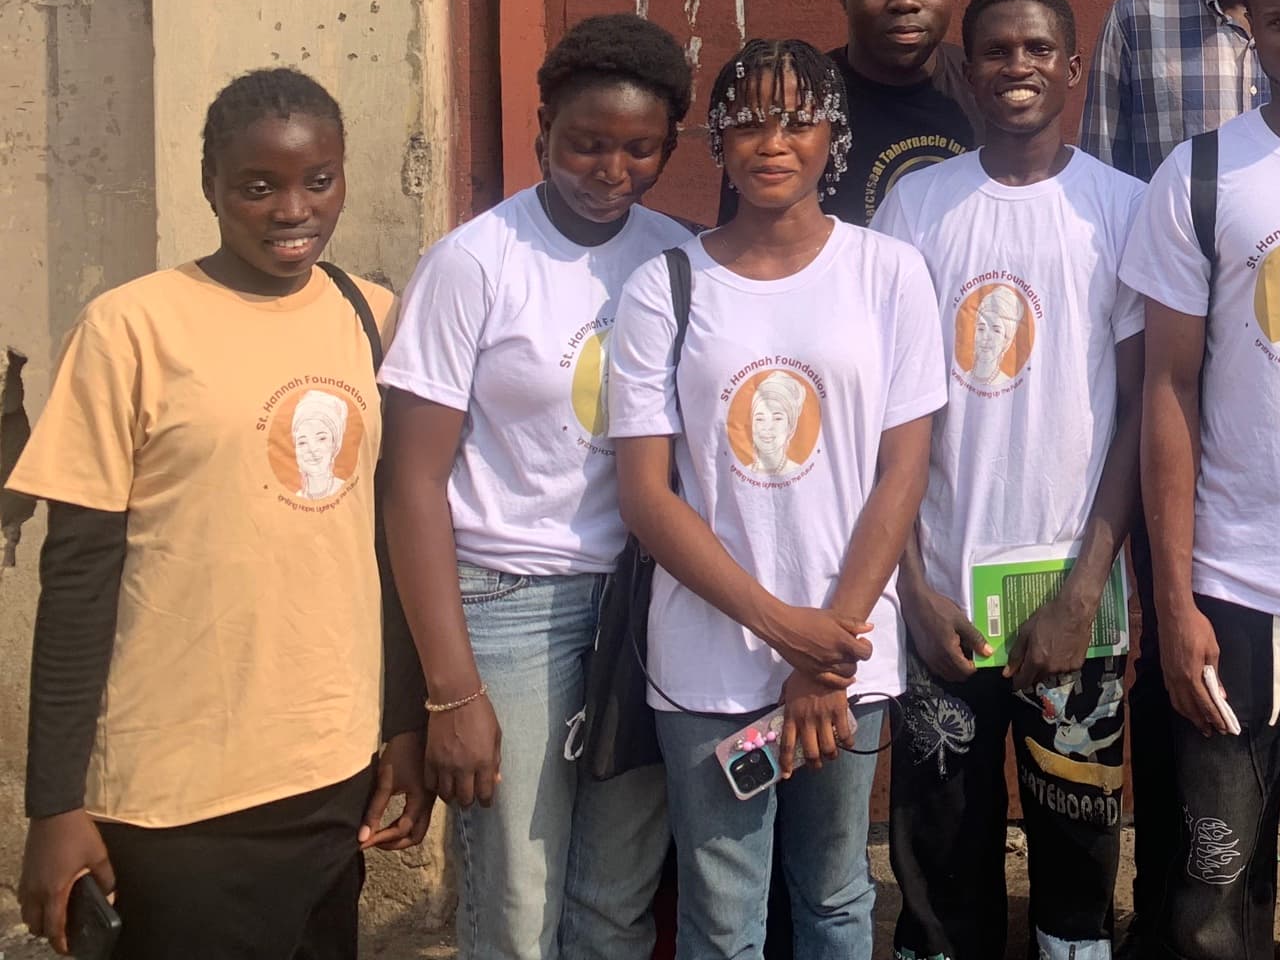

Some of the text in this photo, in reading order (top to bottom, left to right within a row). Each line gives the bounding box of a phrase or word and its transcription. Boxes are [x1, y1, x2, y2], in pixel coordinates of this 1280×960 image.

[1246, 255, 1261, 270] St.
[960, 270, 999, 296] Hannah
[1000, 270, 1043, 319] Foundation
[560, 319, 601, 368] St. Hannah
[256, 375, 367, 431] St. Hannah Foundation
[720, 356, 827, 401] St. Hannah Foundation
